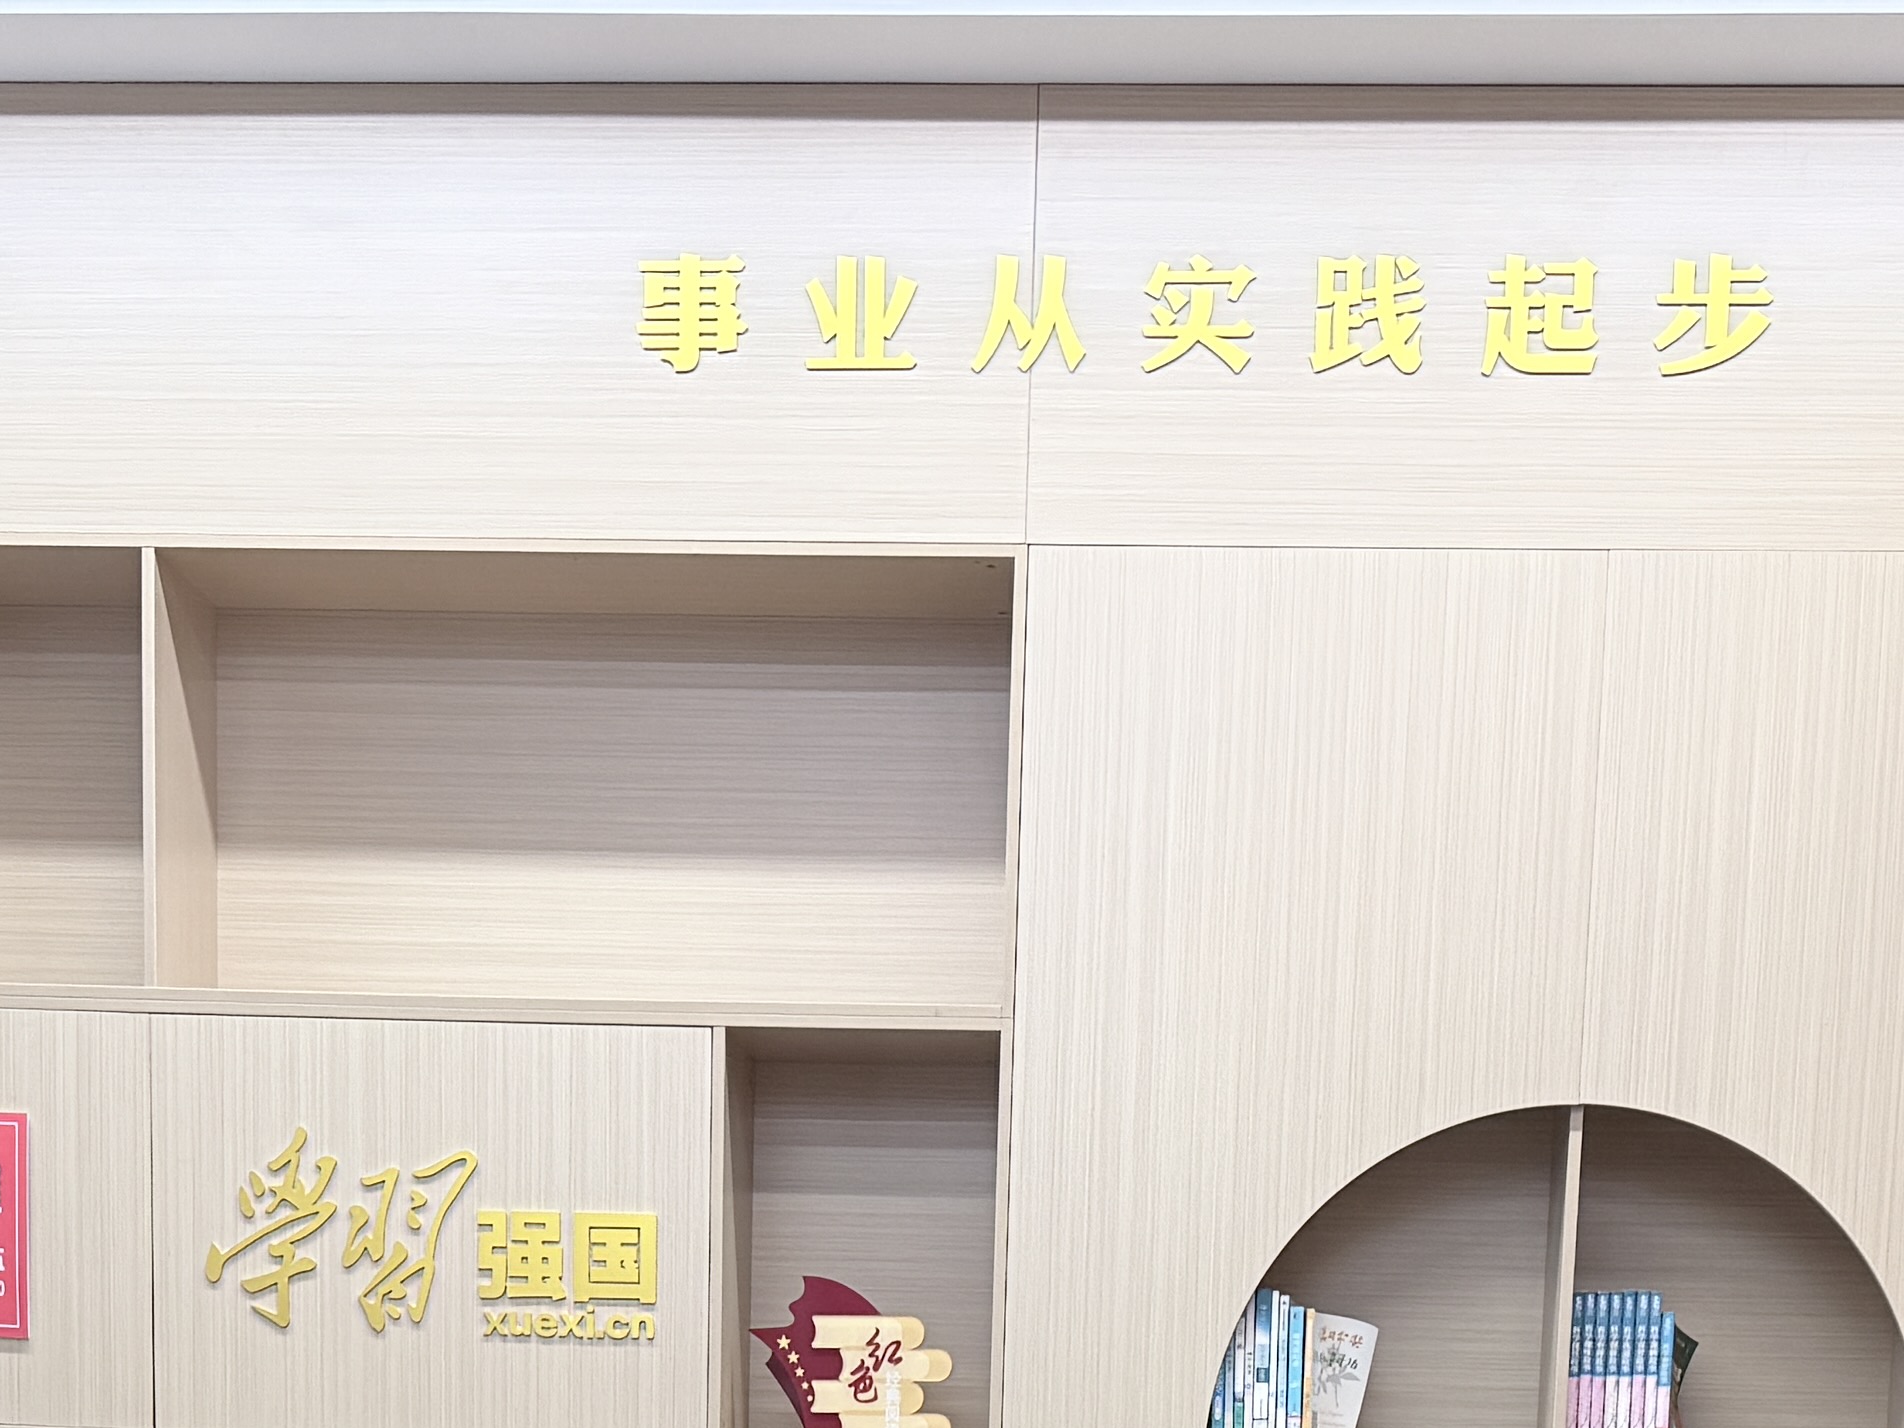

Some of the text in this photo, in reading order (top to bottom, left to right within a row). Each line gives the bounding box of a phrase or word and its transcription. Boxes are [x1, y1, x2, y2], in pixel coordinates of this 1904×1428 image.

[637, 253, 1775, 376] 事业从实践起步
[483, 1305, 656, 1340] xuexi.cn
